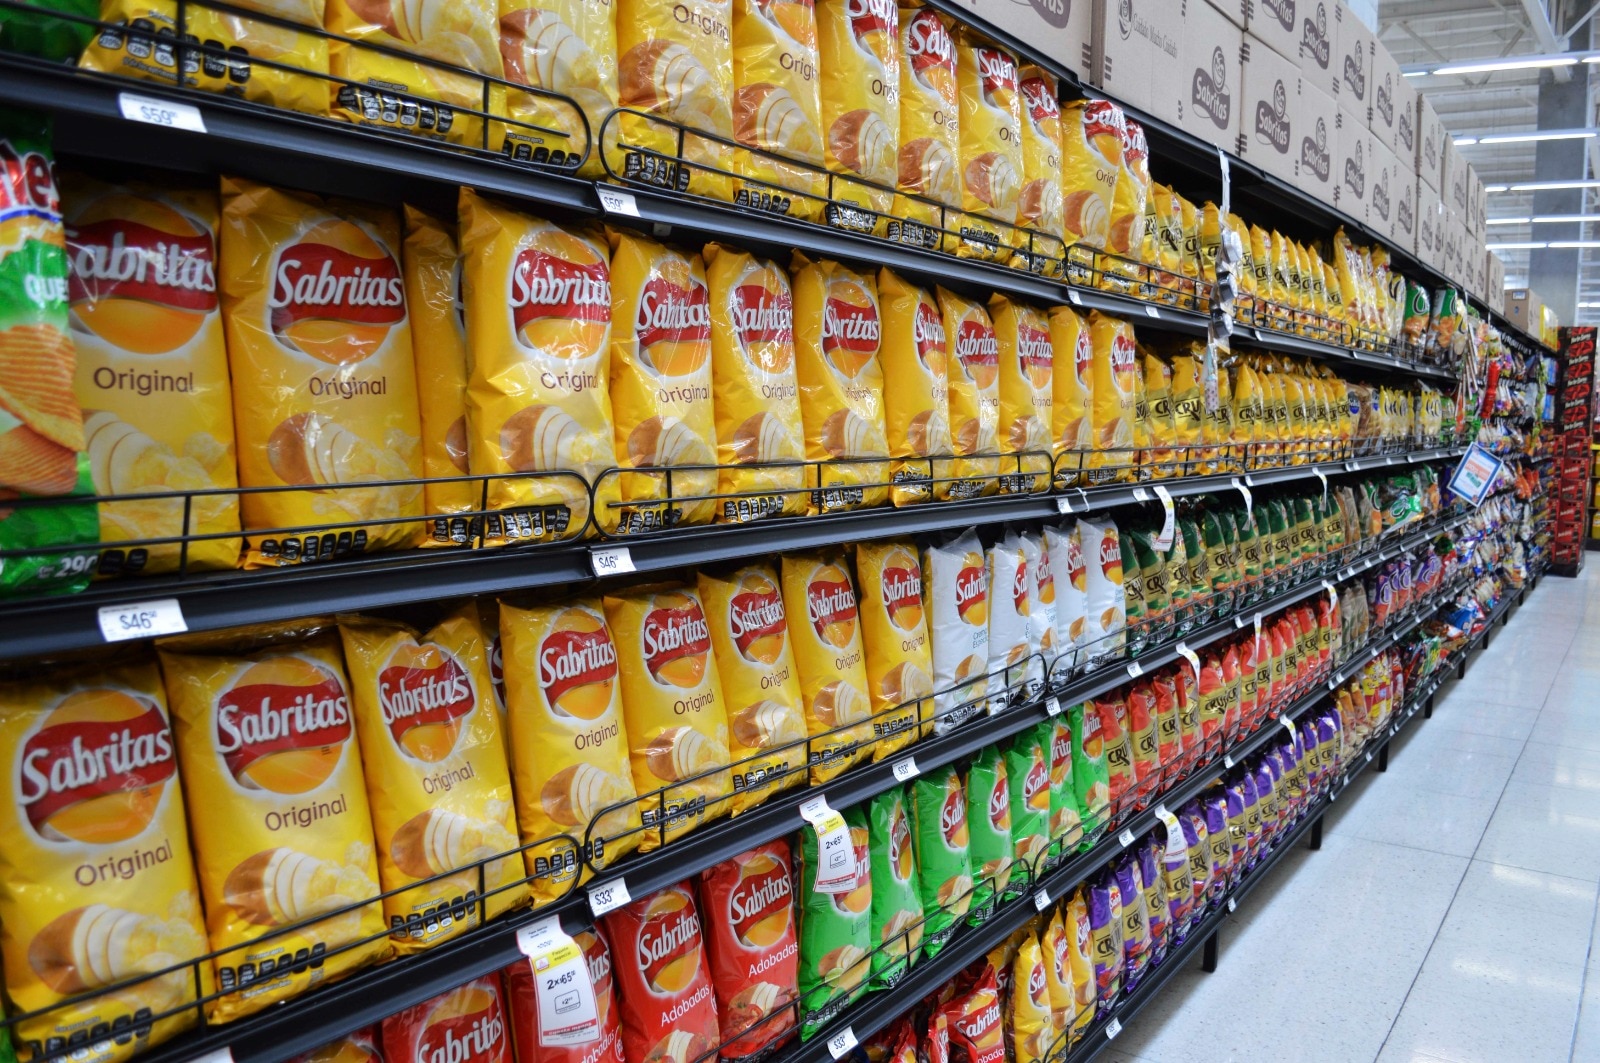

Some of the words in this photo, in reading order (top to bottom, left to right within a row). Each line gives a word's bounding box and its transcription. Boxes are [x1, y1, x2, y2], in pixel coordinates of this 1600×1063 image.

[1196, 77, 1227, 121] Sabritas
[1259, 109, 1288, 145] Sabritas
[269, 259, 405, 308] Sabritas
[635, 291, 711, 331] Sabitas
[94, 367, 194, 396] Original
[309, 376, 387, 399] Original
[660, 384, 710, 403] Original
[643, 615, 708, 661] Sabritas
[539, 638, 615, 689] Sabritas
[380, 674, 470, 726] Sabritas
[674, 690, 715, 715] Original
[217, 693, 348, 754] Sabritas
[574, 721, 619, 750] Original
[18, 729, 171, 806] Sabritas
[423, 761, 474, 794] Original
[264, 794, 347, 832] Original
[75, 839, 173, 887] Original
[729, 873, 791, 924] Sabritas
[639, 911, 700, 971] Sabritas
[748, 942, 798, 978] Adobadas
[661, 983, 709, 1027] Adobadas
